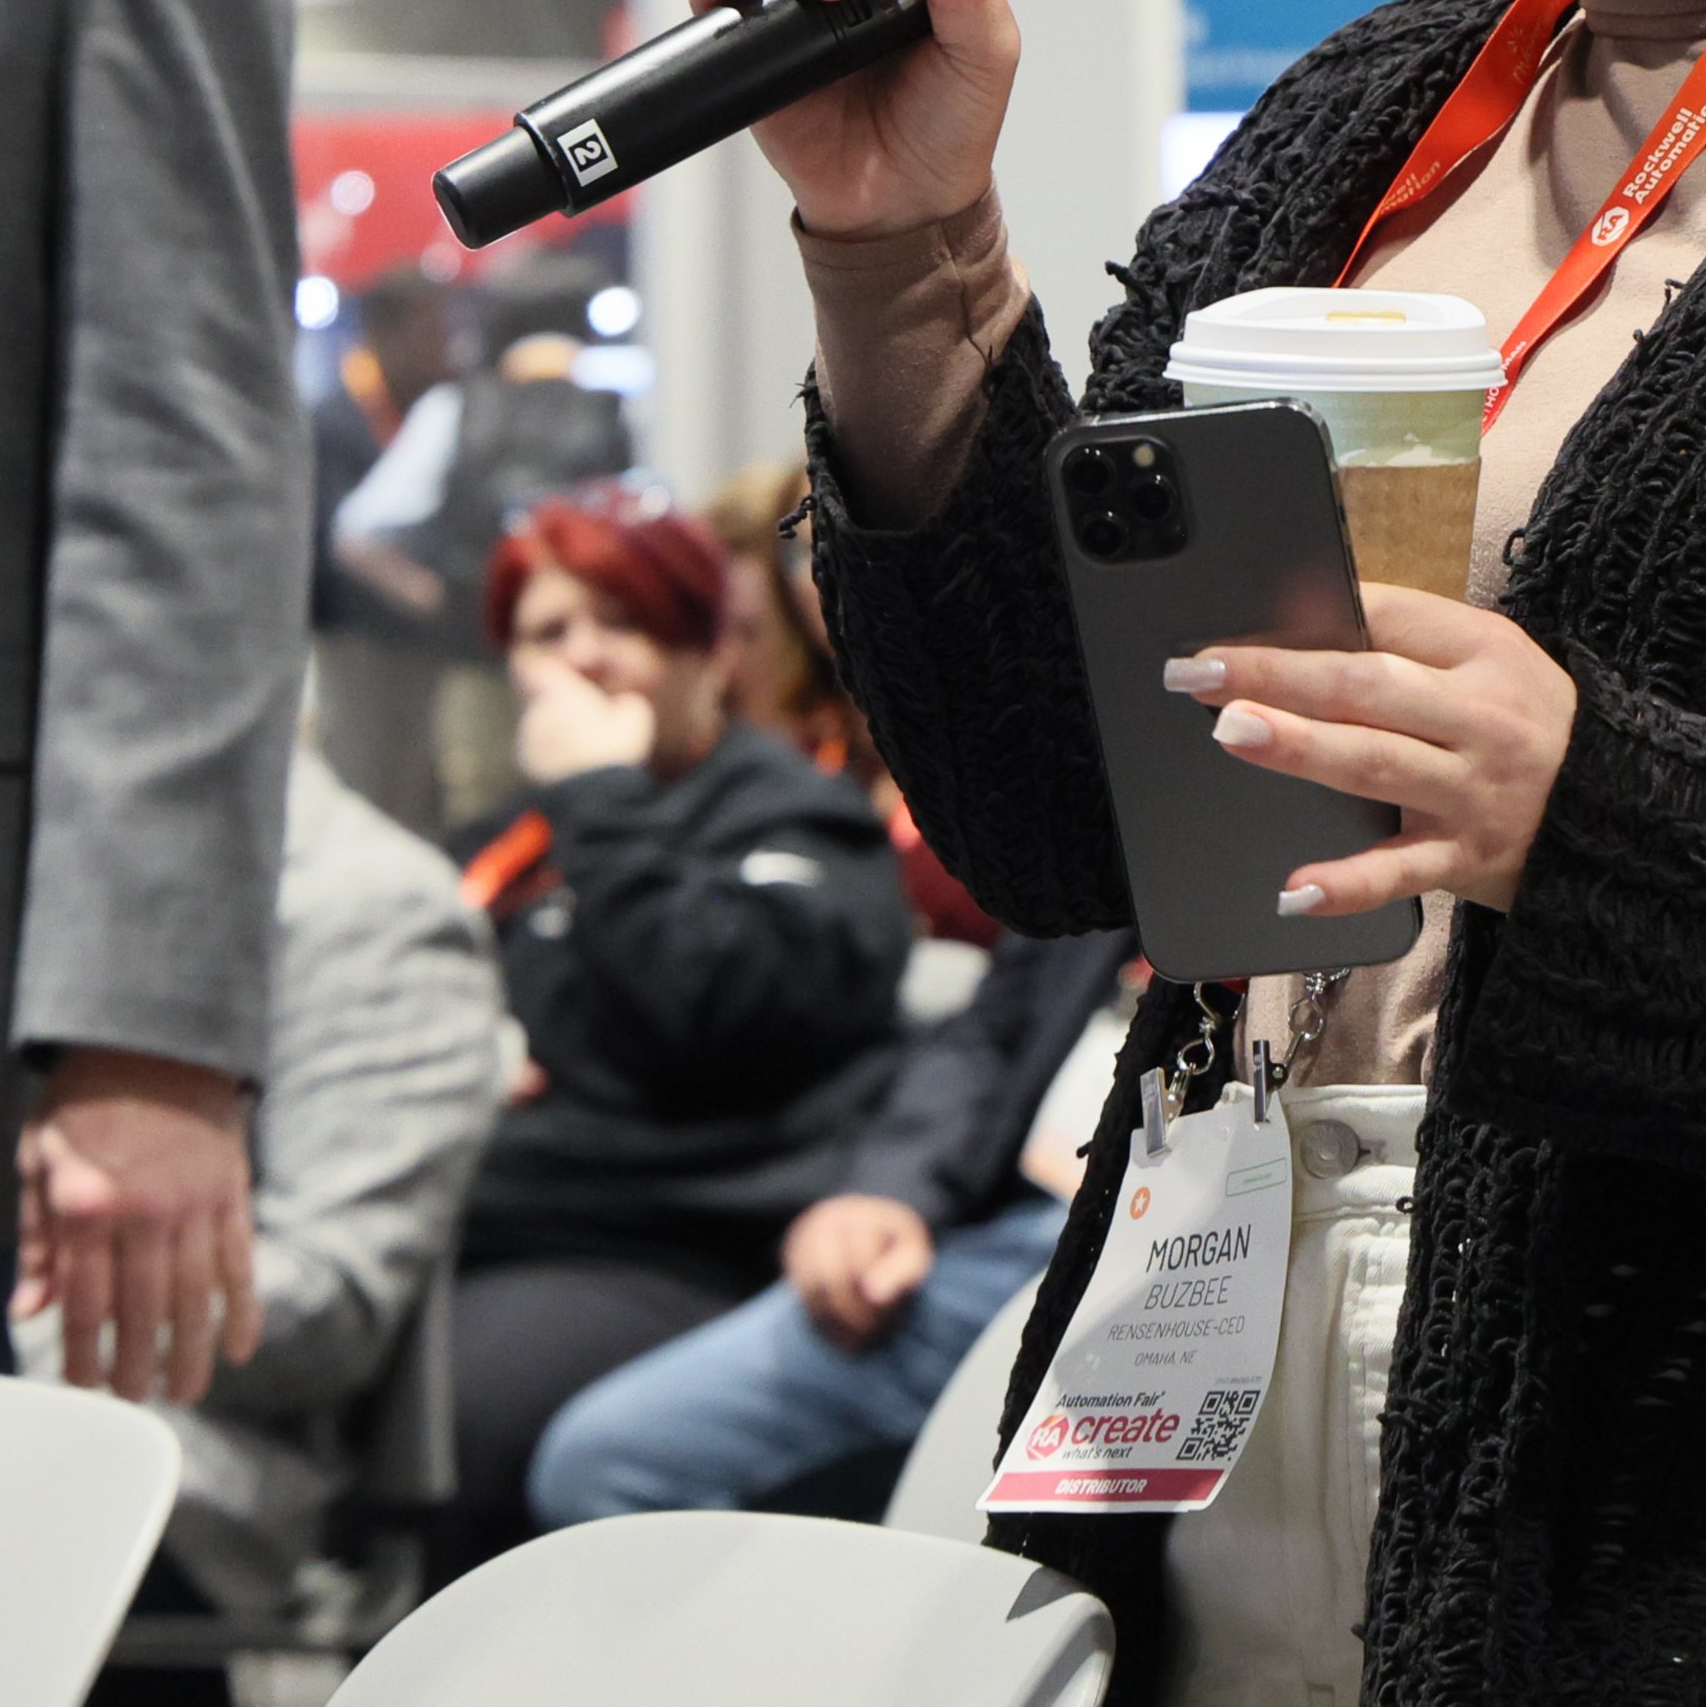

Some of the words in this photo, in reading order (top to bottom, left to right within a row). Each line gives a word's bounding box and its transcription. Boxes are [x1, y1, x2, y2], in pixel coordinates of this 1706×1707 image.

[574, 140, 602, 165] 2
[1622, 107, 1693, 198] Rockwell
[1145, 1224, 1252, 1273] MORGAN
[1144, 1275, 1233, 1310] BUZBEE
[1107, 1315, 1245, 1341] RENSENHOUSE-CED
[1179, 1349, 1198, 1366] NE
[1056, 1392, 1133, 1408] Automation
[1071, 1408, 1181, 1445] create
[1062, 1446, 1102, 1460] what's
[1103, 1446, 1133, 1459] next
[1055, 1478, 1147, 1495] DISTRIBUTOR
